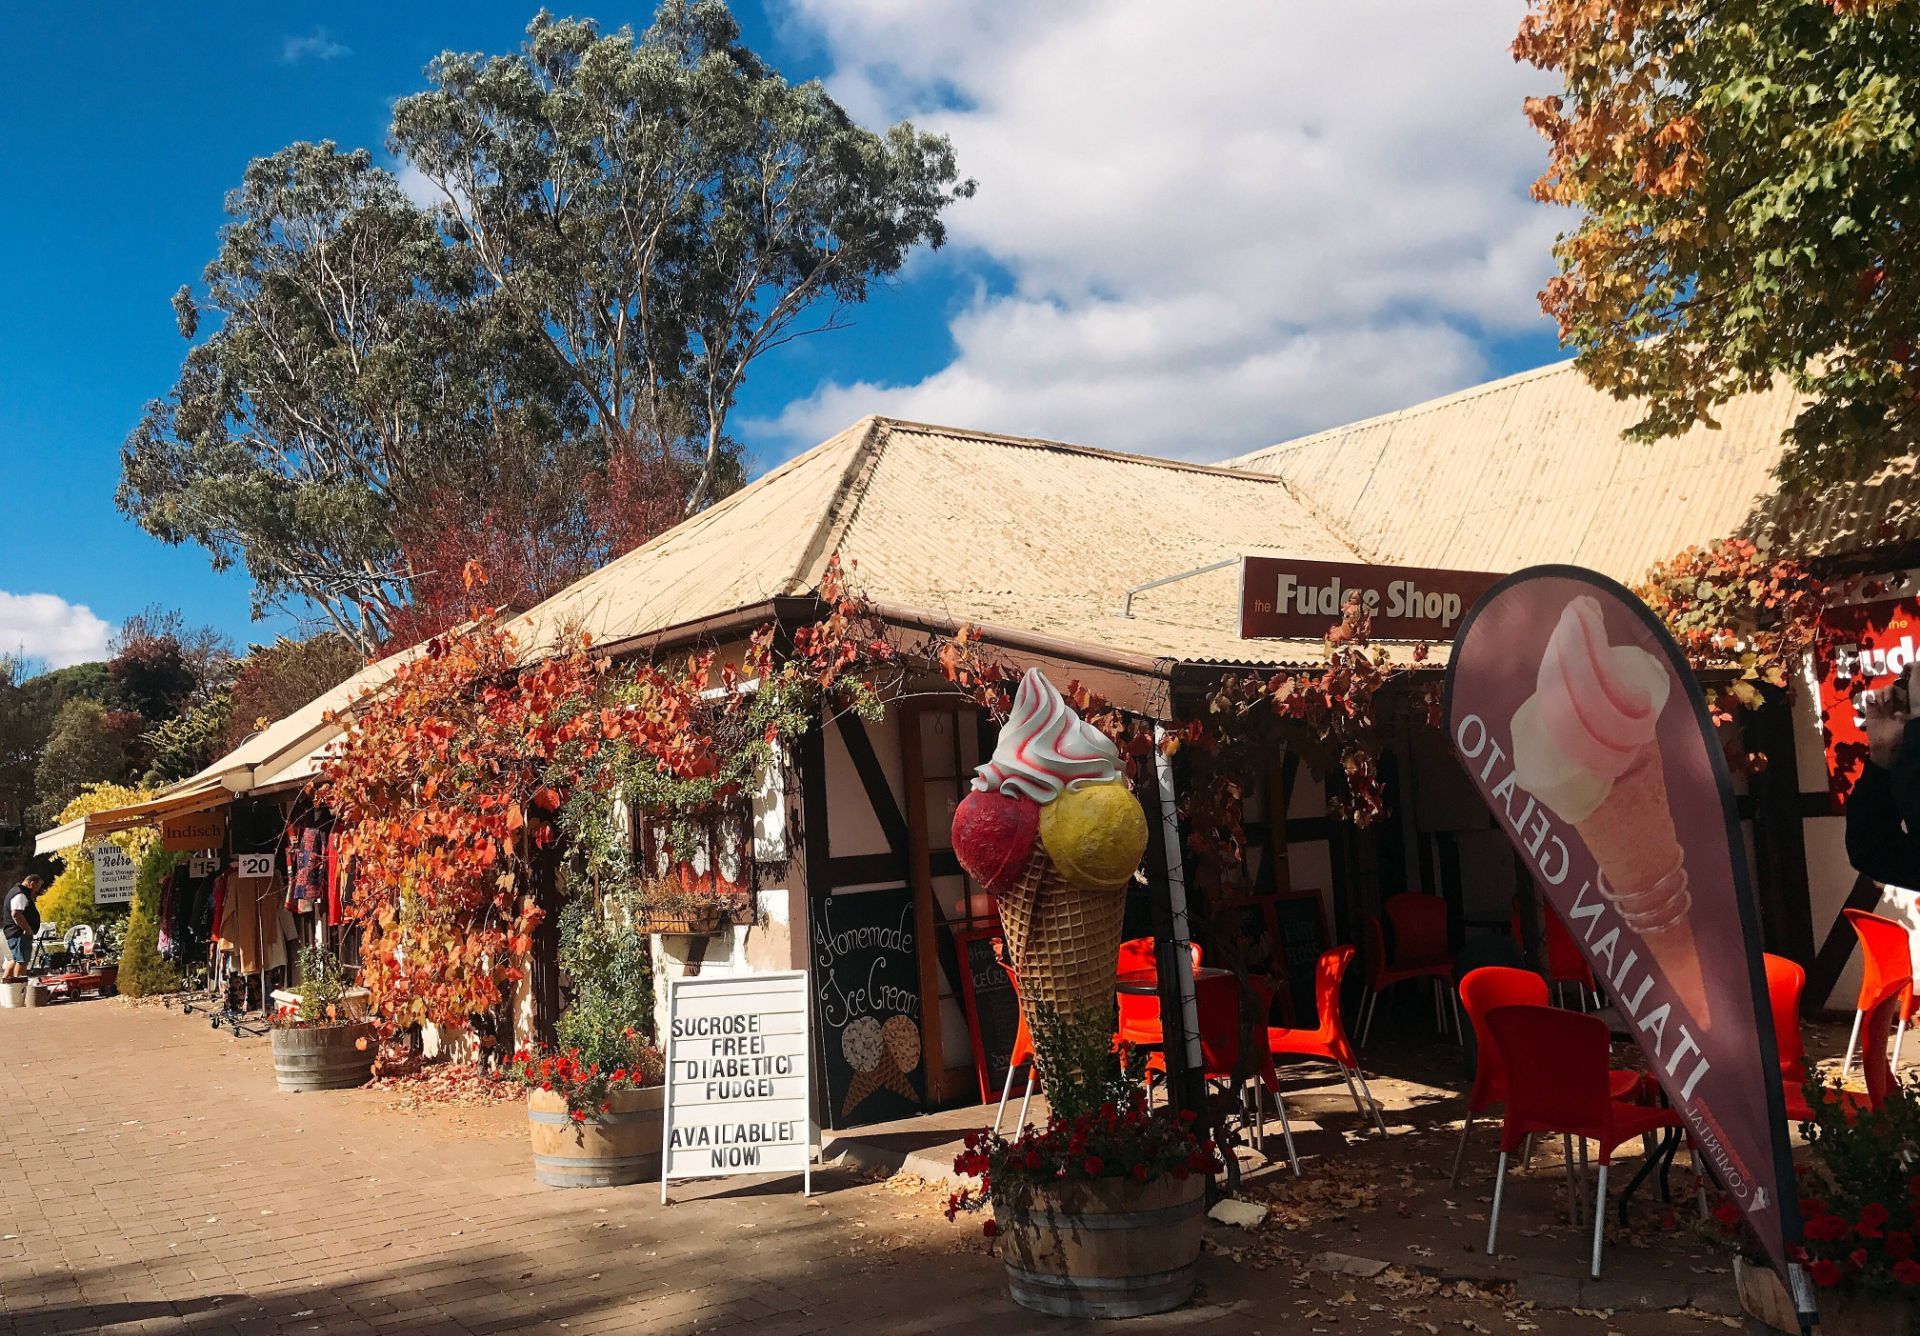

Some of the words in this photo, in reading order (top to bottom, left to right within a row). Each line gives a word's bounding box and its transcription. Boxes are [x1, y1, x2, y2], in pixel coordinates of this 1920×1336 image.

[1254, 599, 1271, 613] the
[1386, 580, 1461, 628] Shop
[167, 824, 220, 839] Indisch
[102, 853, 132, 868] Retro
[242, 858, 270, 874] $20
[816, 897, 913, 967] Homemade
[820, 967, 868, 1028] Ice
[867, 956, 920, 1020] Cream
[671, 1014, 758, 1037] SUCROSE
[711, 1036, 760, 1056] FREE
[687, 1055, 788, 1079] DIABETIC
[706, 1079, 768, 1100] FUDGE
[669, 1122, 789, 1149] AVAILABLE
[711, 1146, 757, 1168] NOW
